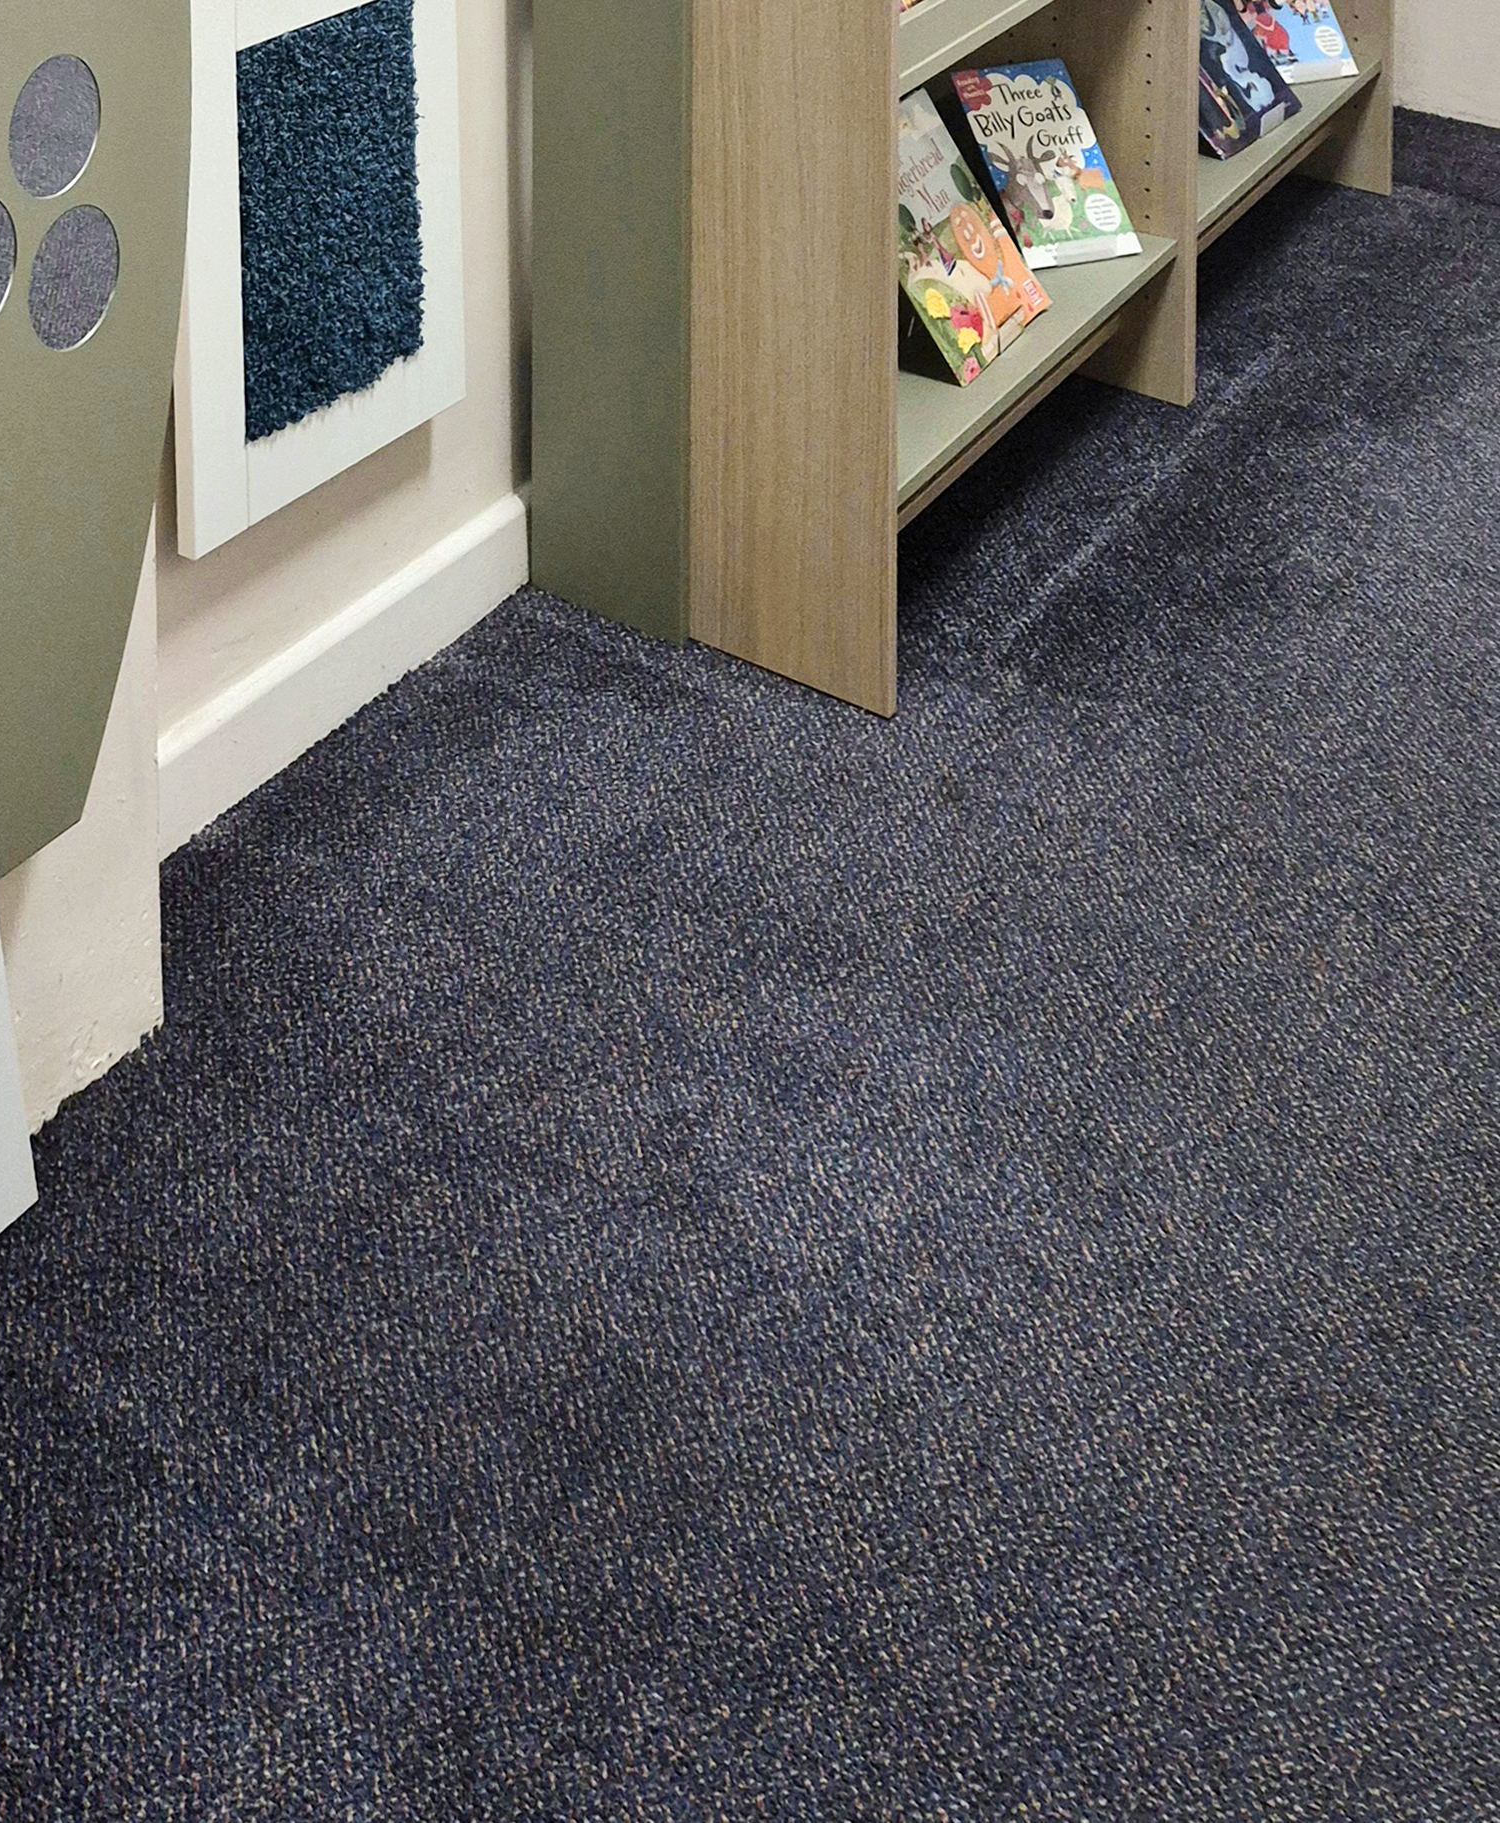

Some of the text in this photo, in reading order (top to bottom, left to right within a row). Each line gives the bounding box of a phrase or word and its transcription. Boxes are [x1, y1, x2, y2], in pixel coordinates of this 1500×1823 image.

[992, 83, 1043, 105] Three
[973, 101, 1072, 140] Billy Goats
[1037, 125, 1084, 147] Gruff
[916, 182, 950, 220] Man
